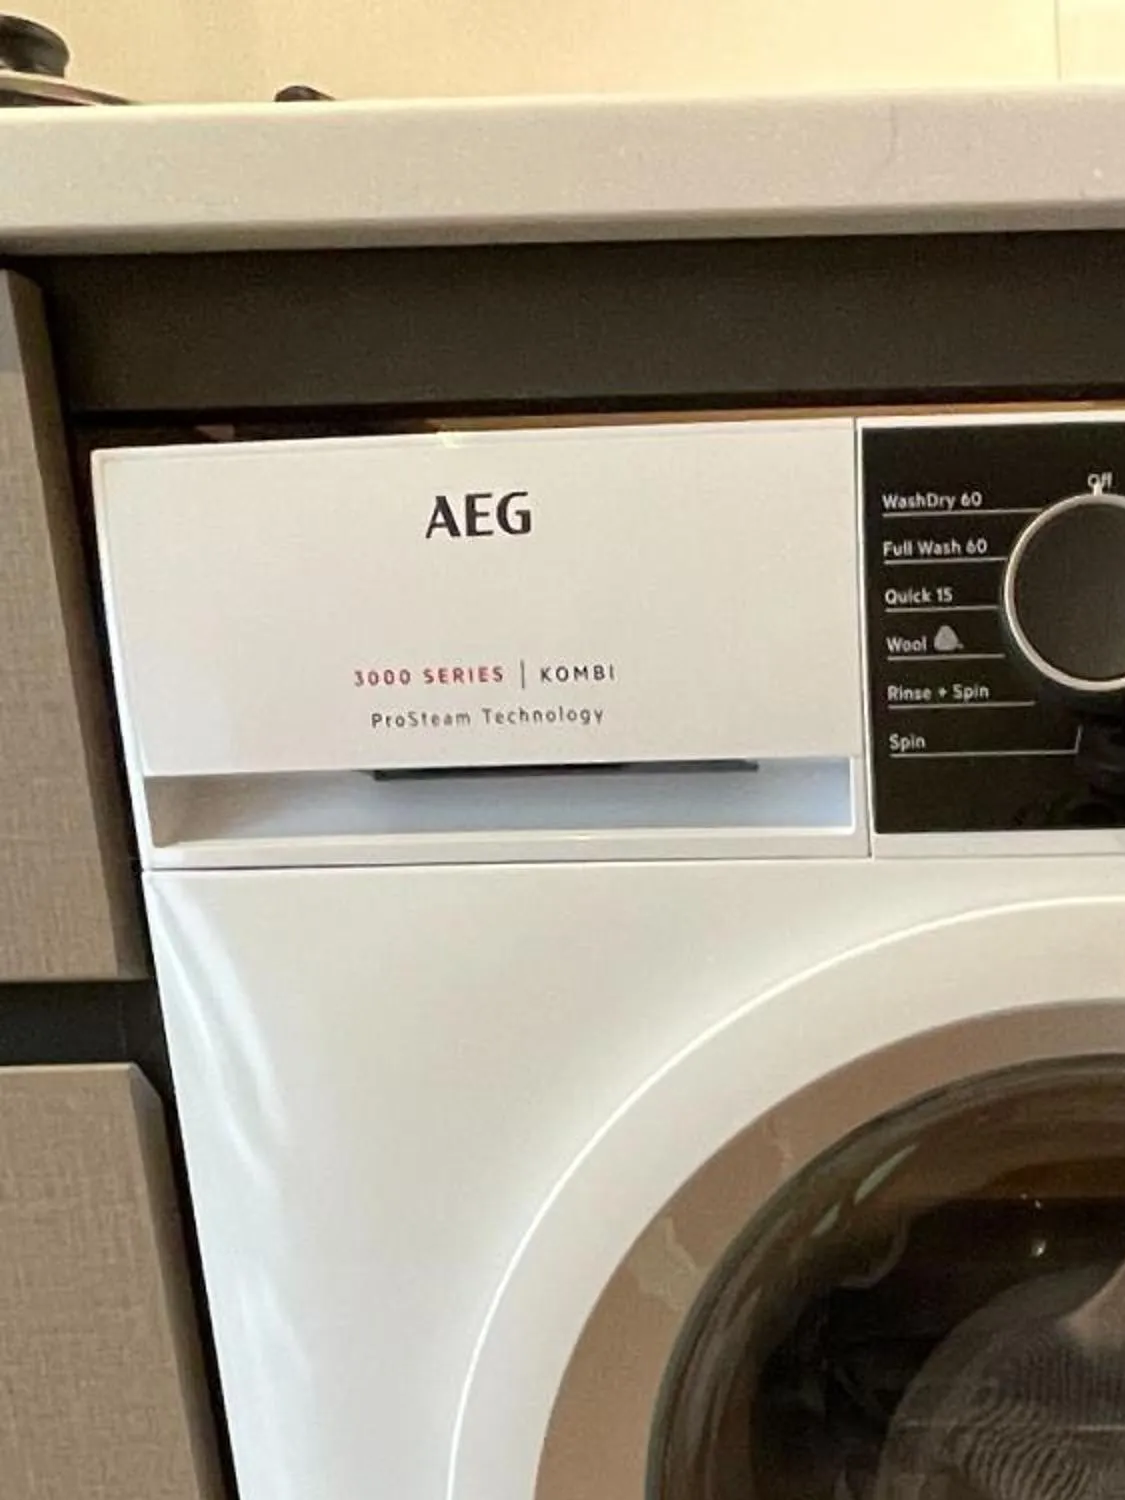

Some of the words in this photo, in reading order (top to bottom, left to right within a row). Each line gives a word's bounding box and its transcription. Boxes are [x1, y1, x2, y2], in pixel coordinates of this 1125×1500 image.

[1087, 471, 1113, 488] Off
[882, 492, 956, 510] WashDry
[960, 491, 983, 507] 60
[425, 491, 533, 538] AEG
[883, 539, 913, 557] Full
[917, 538, 961, 555] Wash
[965, 538, 988, 554] 60
[885, 587, 931, 605] Quick
[936, 587, 953, 602] 15
[886, 635, 927, 652] Wool
[353, 669, 411, 687] 3000
[423, 666, 504, 684] SERIES
[540, 664, 616, 683] KOMBI
[887, 684, 931, 700] Rinse
[952, 683, 989, 703] Spin
[371, 709, 471, 728] ProSteam
[481, 705, 604, 728] Technology
[889, 733, 926, 752] Spin
